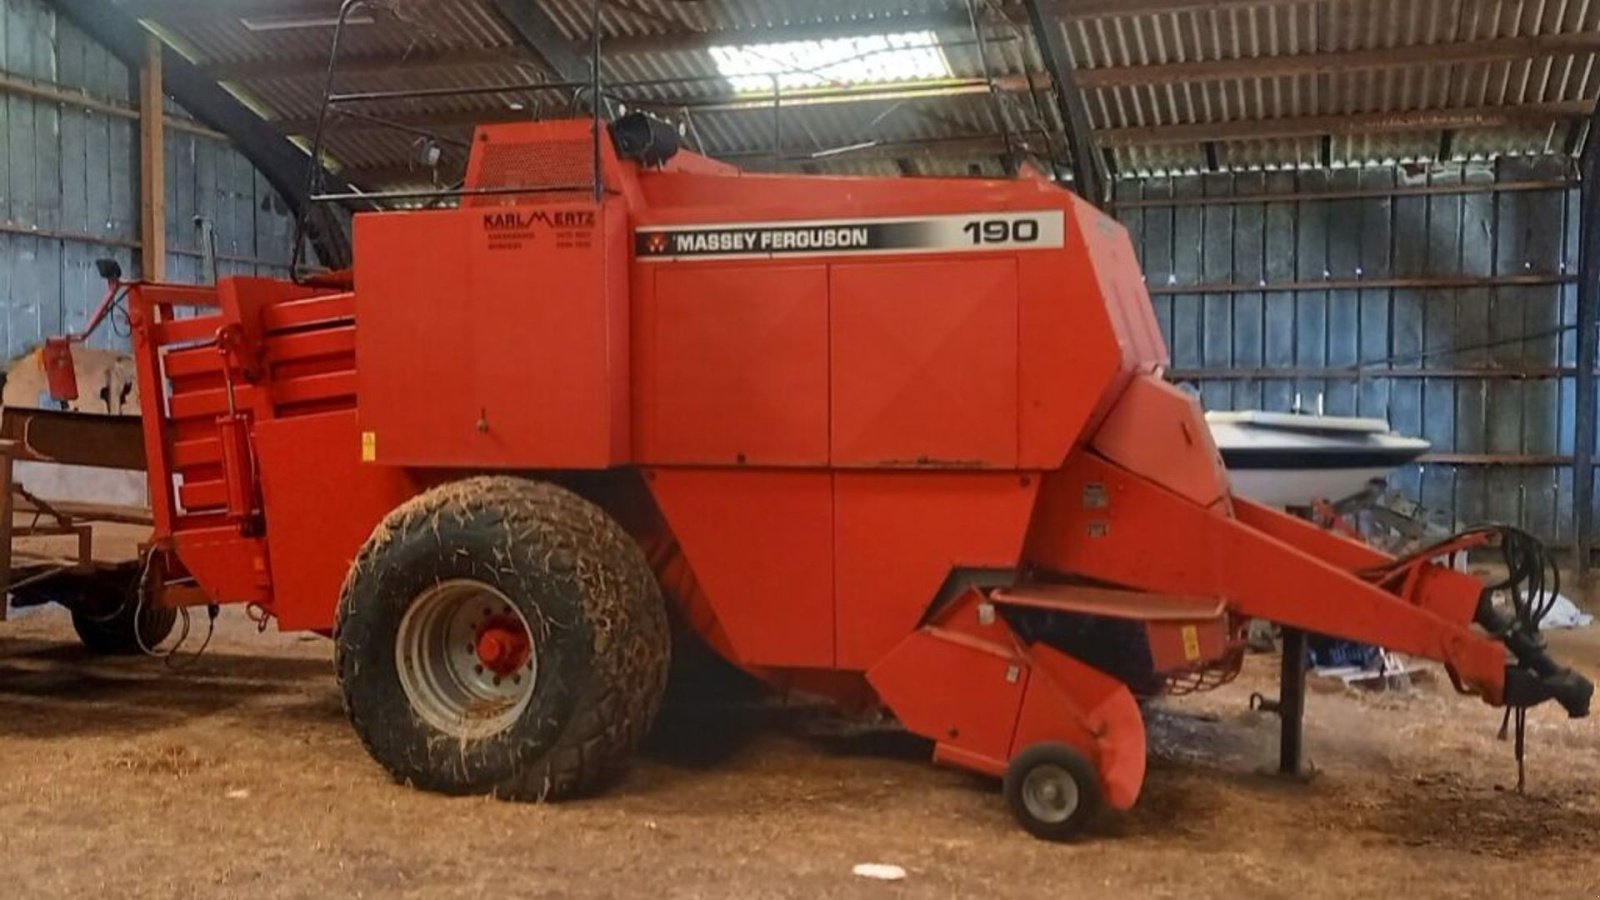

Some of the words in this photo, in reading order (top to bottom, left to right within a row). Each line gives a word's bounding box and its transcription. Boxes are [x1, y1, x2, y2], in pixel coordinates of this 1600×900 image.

[676, 231, 756, 252] MASSEY
[761, 228, 868, 249] FERGUSON
[963, 219, 1039, 244] 190
